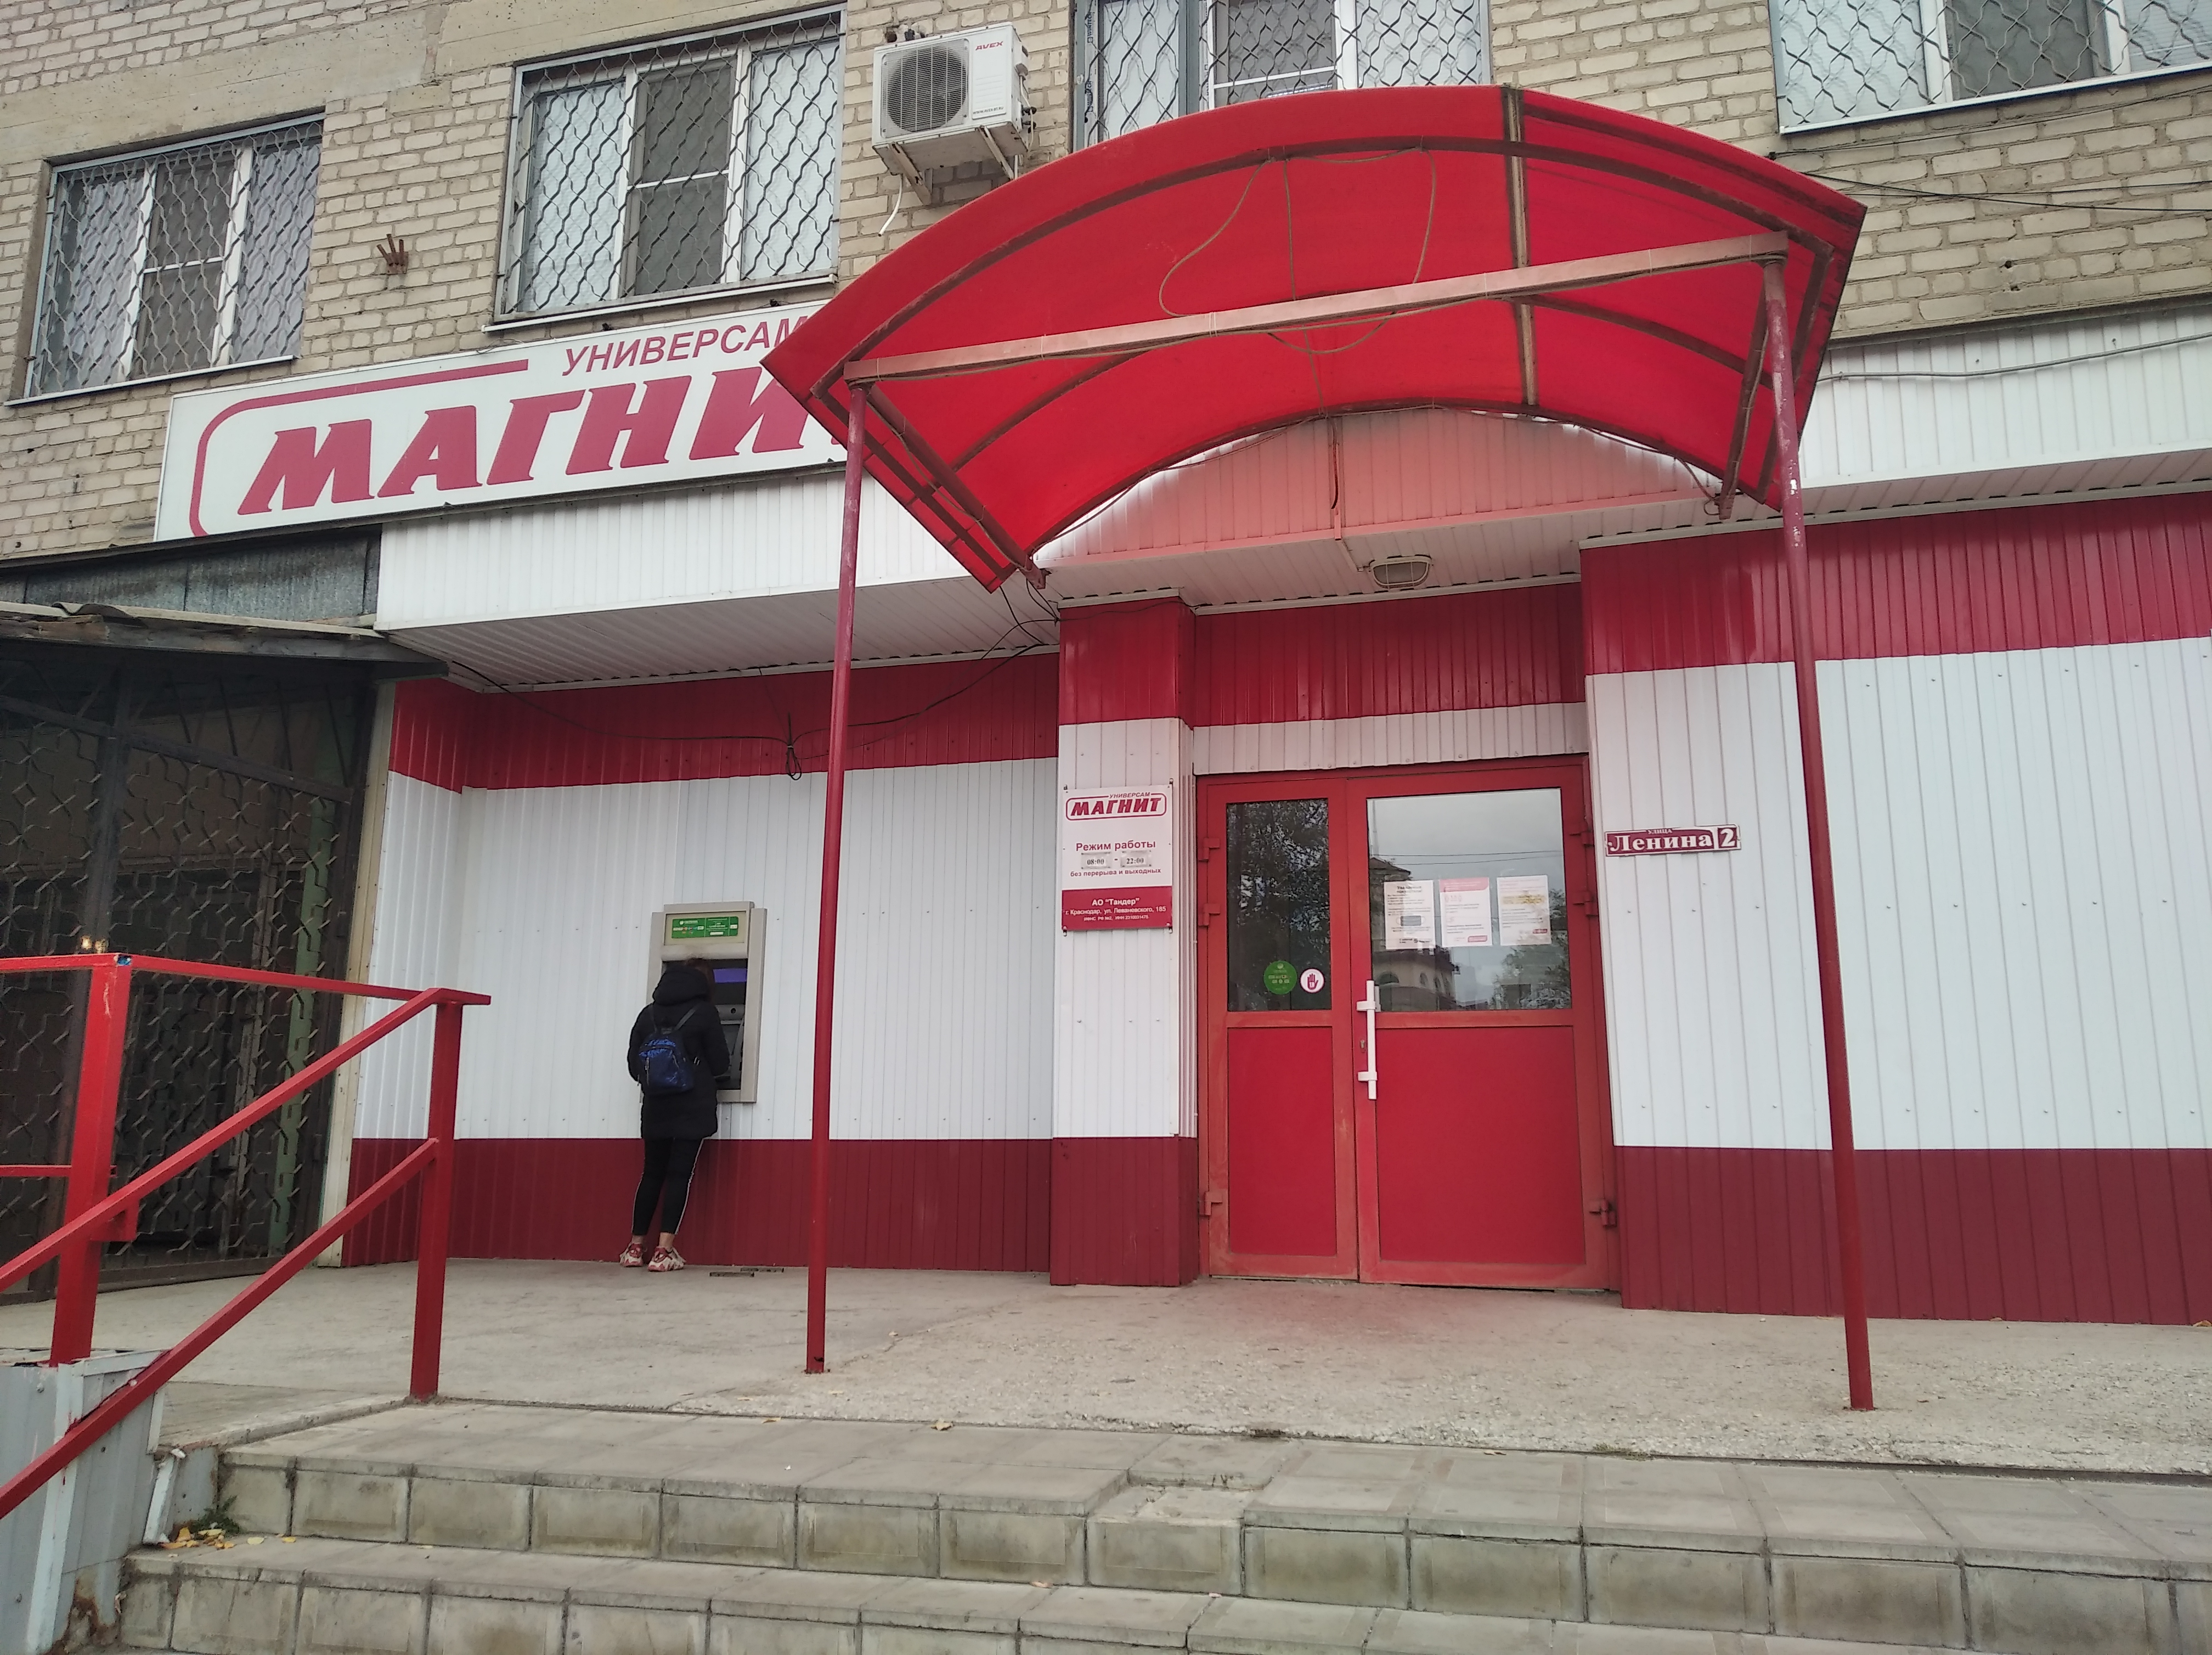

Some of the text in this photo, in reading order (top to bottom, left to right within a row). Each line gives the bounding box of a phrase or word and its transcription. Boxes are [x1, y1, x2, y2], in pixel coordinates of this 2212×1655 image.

[975, 41, 1003, 50] AVEX
[237, 366, 845, 516] МАГНИ
[1070, 797, 1161, 817] МАГНИТ
[1076, 840, 1155, 851] Режим работы
[1610, 828, 1736, 852] Ленина 2
